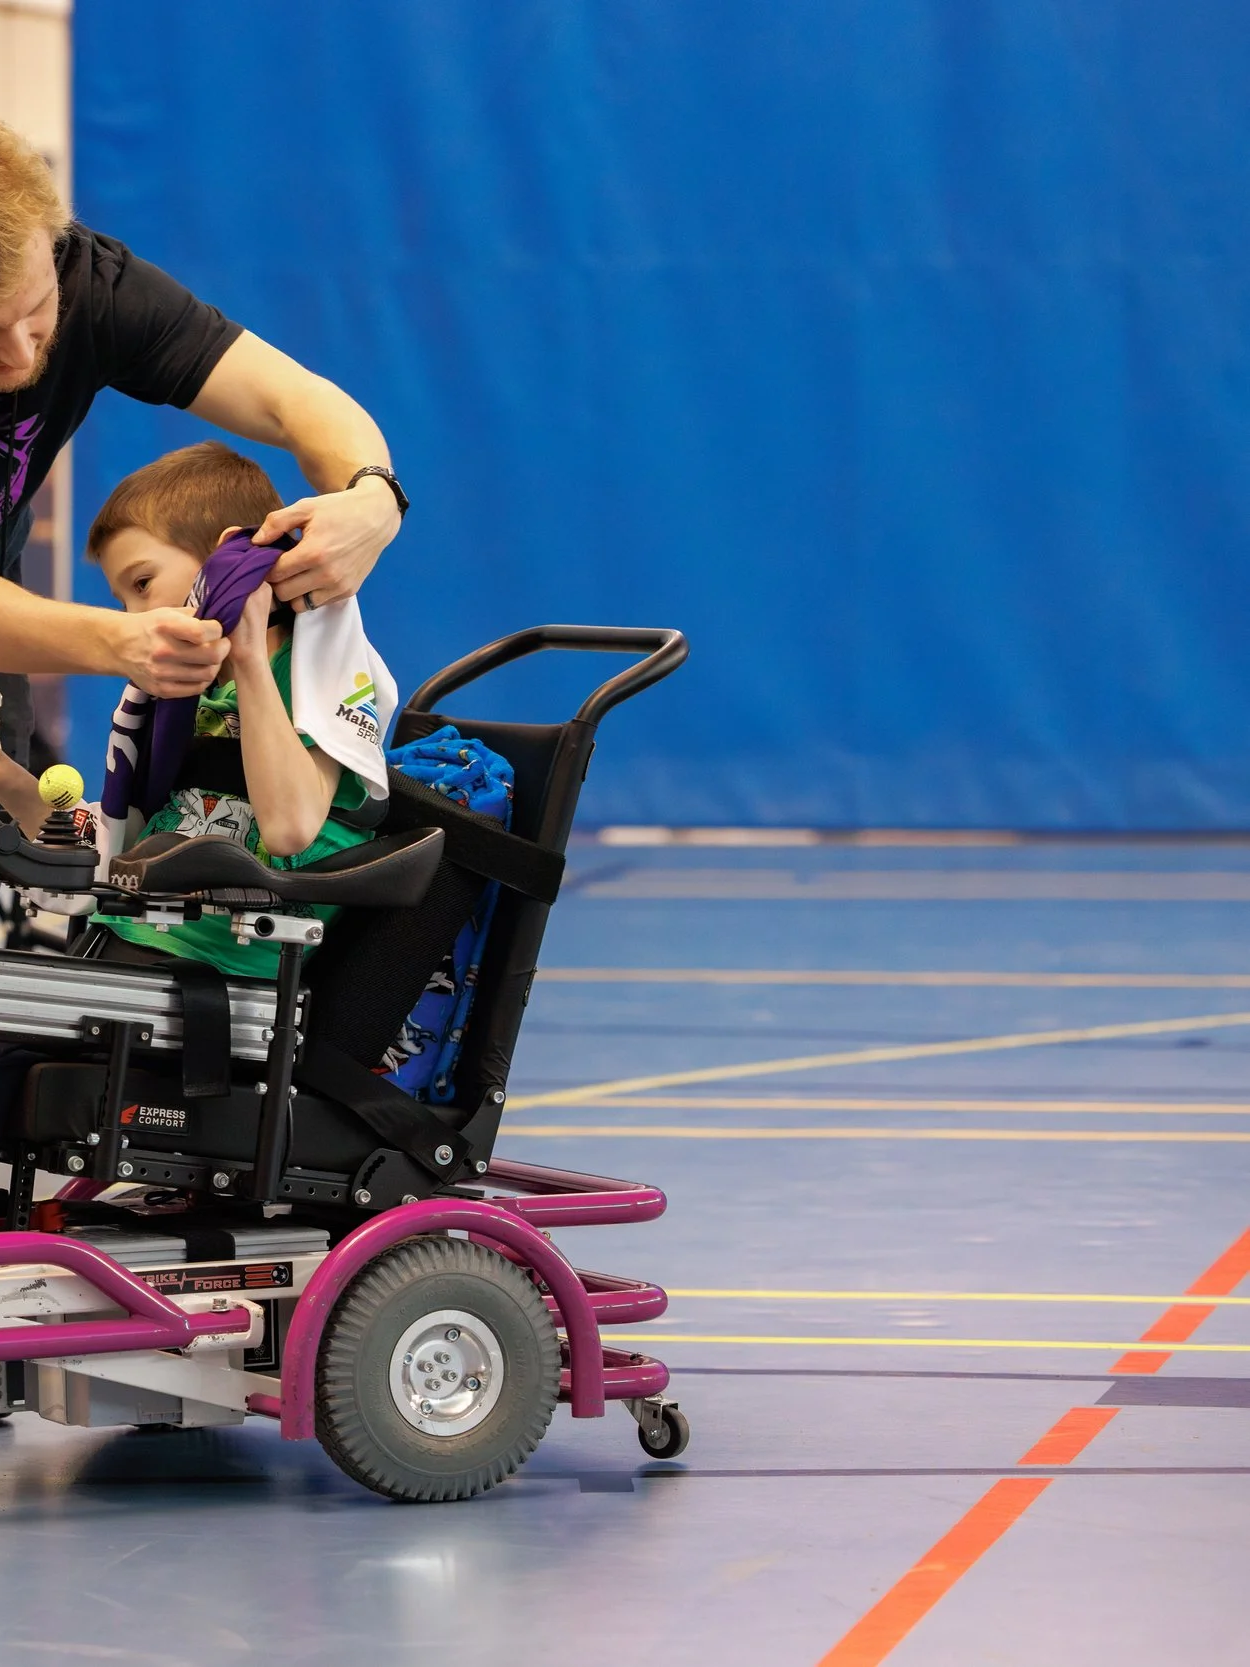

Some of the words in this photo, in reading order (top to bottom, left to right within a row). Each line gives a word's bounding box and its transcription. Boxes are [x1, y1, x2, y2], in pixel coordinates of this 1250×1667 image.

[139, 1106, 186, 1120] EXPRESS
[138, 1116, 185, 1128] COMFORT
[138, 1272, 178, 1284] TRIKE
[194, 1278, 241, 1291] FORCE
